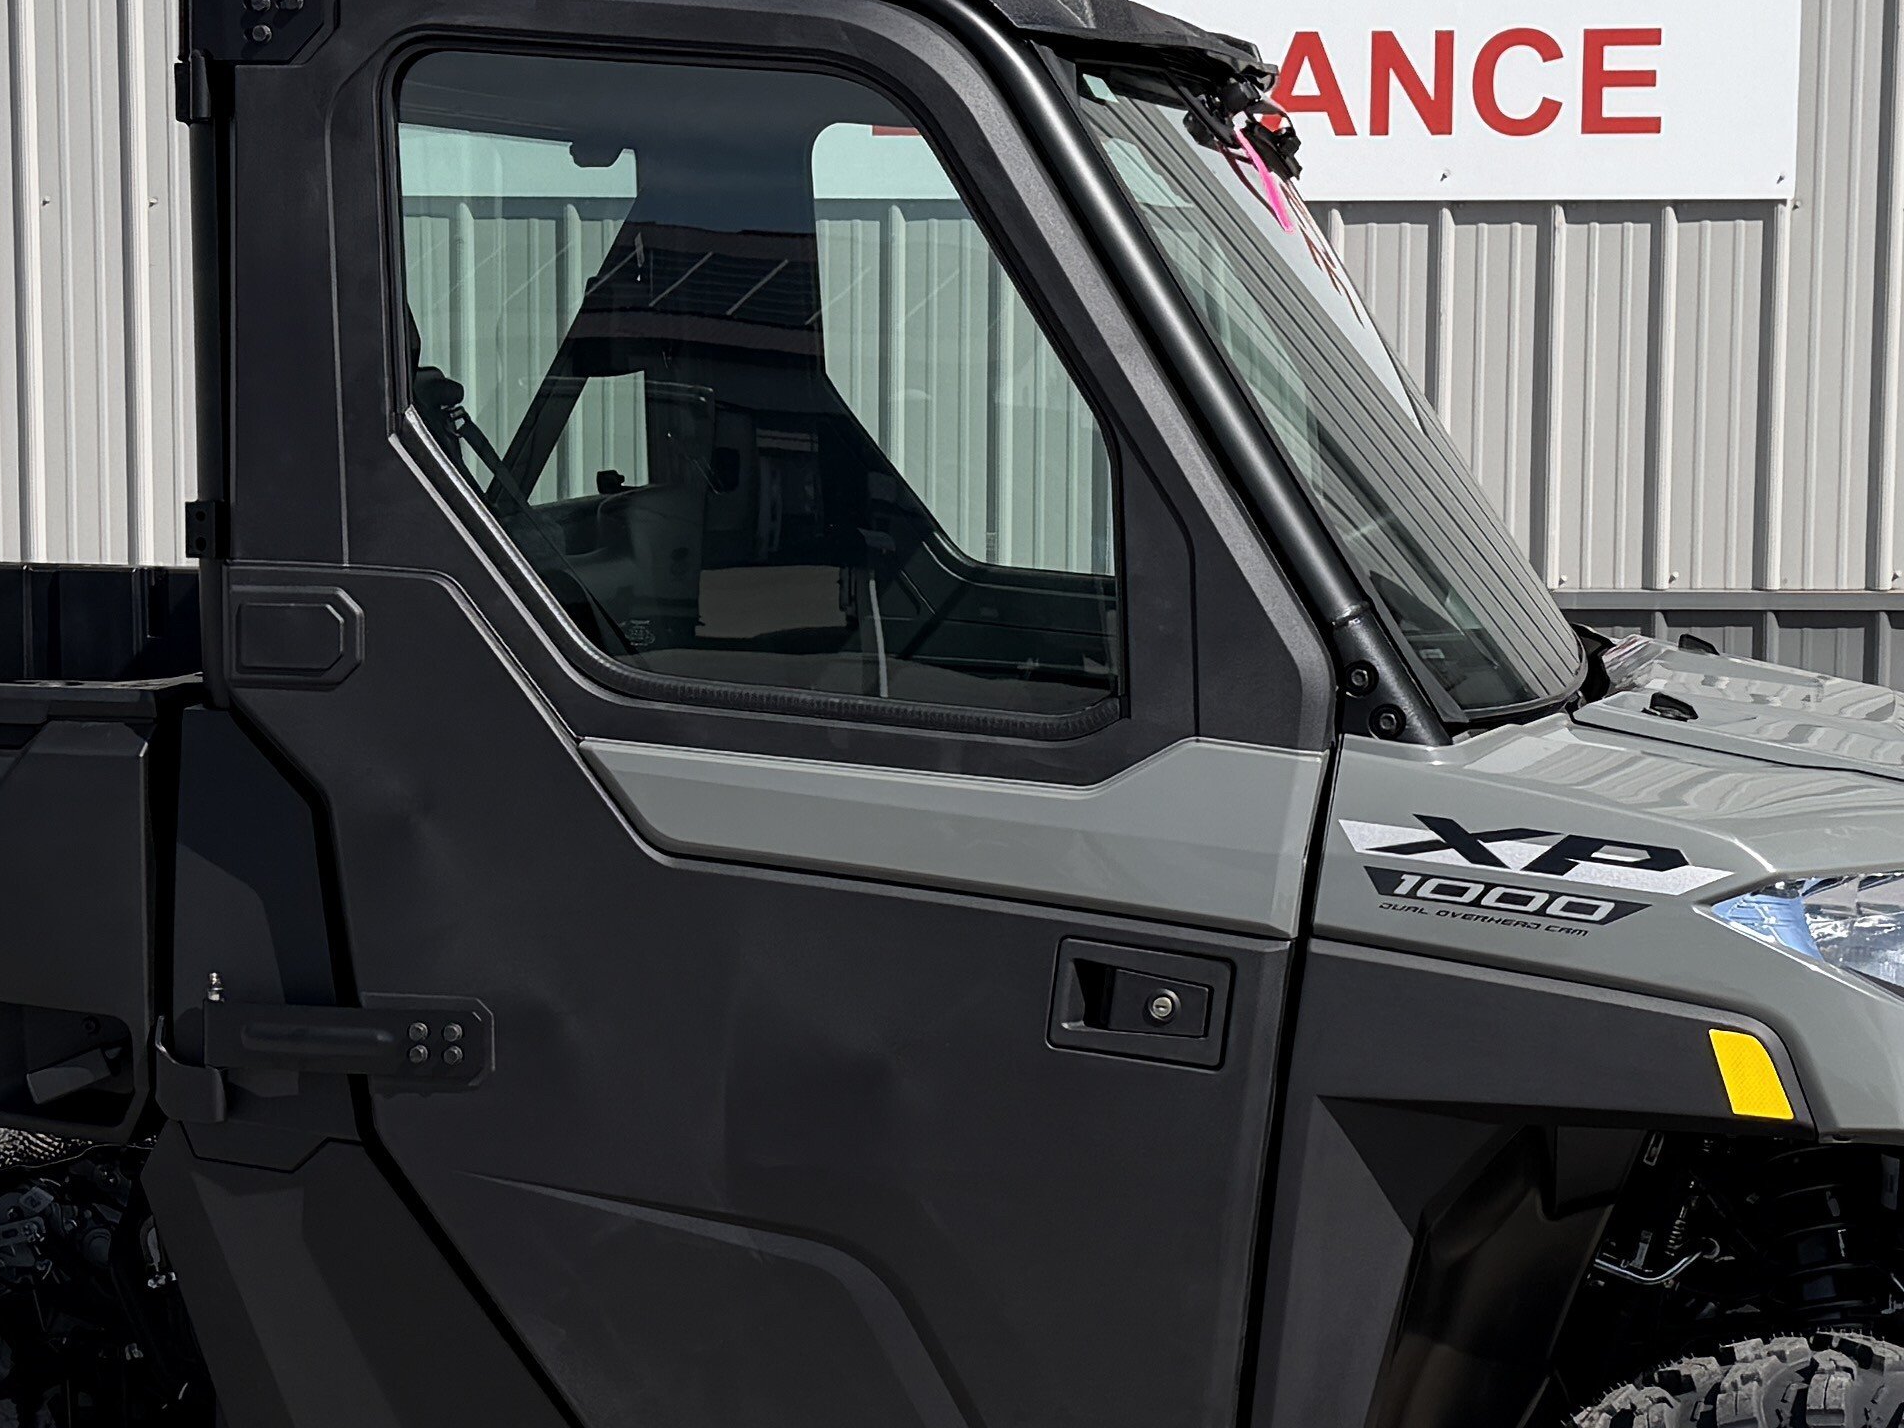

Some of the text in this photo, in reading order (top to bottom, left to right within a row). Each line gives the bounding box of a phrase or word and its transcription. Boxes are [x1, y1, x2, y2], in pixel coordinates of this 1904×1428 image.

[1256, 25, 1663, 137] ANCE
[1363, 812, 1690, 877] XP
[1378, 902, 1590, 938] DUAL OVERHEAD CAM
[1392, 874, 1616, 922] 1000
